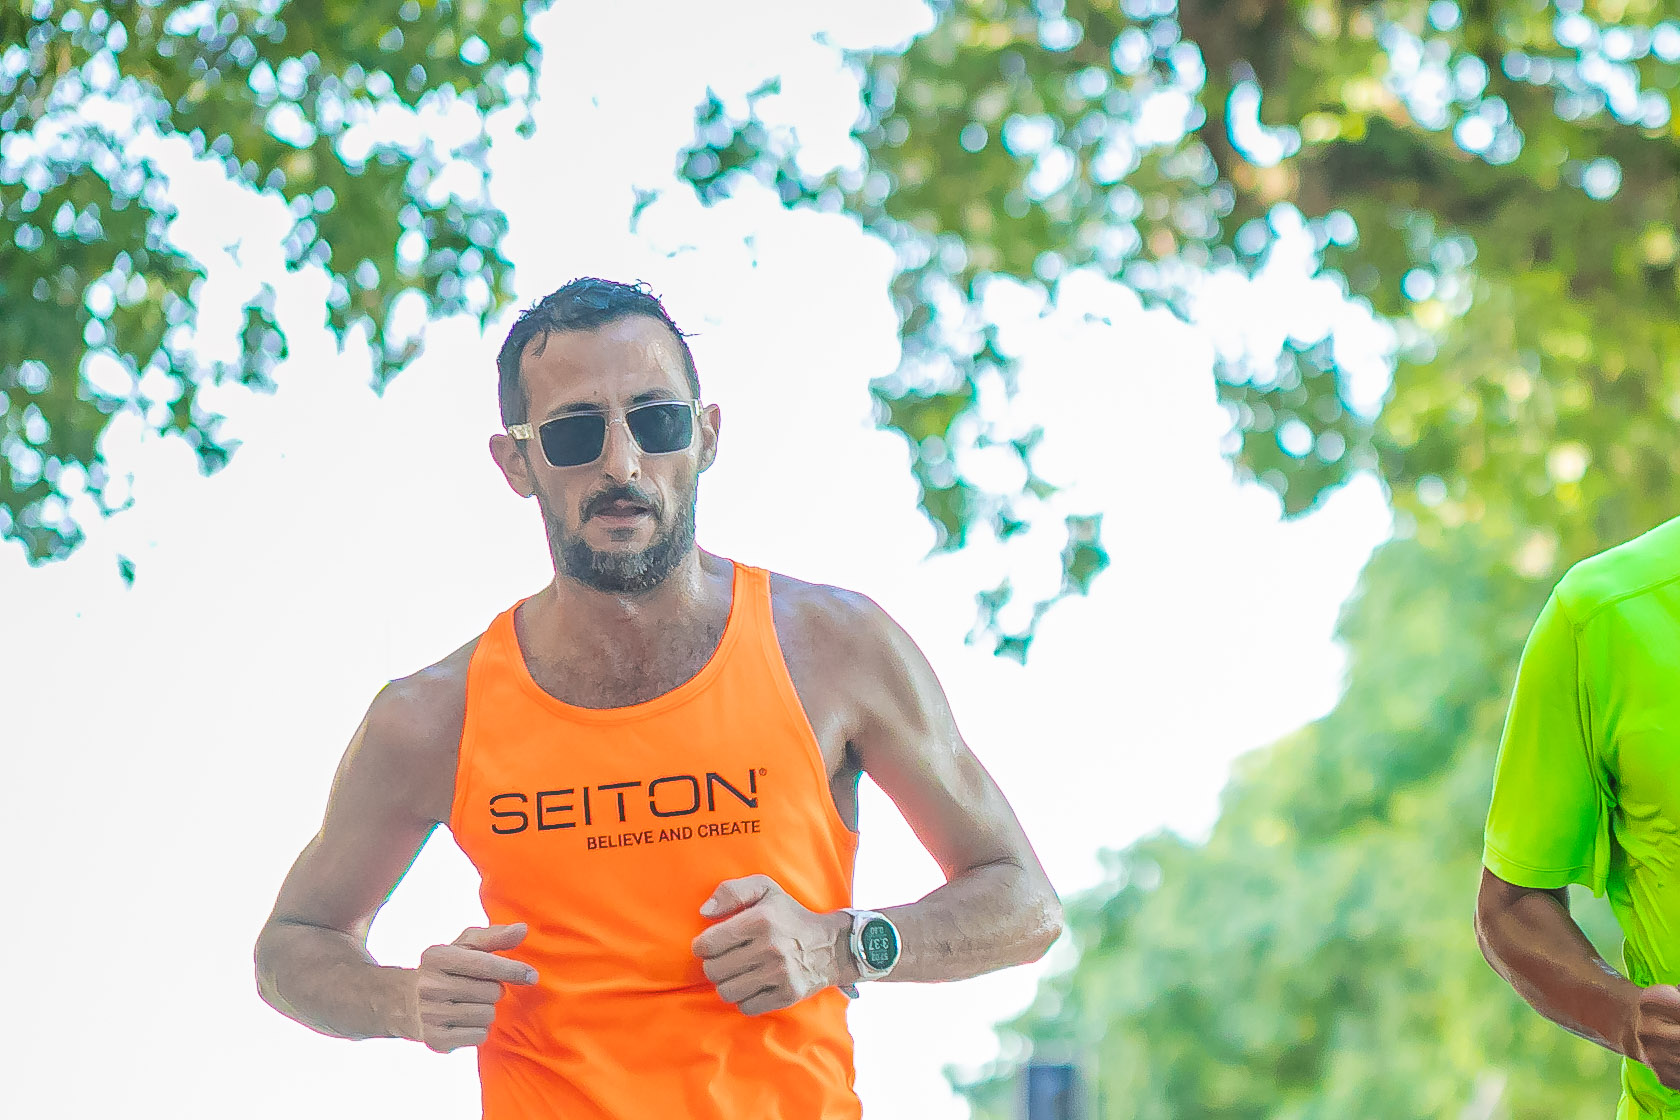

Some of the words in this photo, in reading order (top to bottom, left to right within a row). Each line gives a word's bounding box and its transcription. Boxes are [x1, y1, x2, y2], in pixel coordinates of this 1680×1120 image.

[489, 768, 759, 835] SEITON
[587, 830, 654, 850] BELIEVE
[658, 826, 693, 842] AND
[697, 820, 761, 838] CREATE
